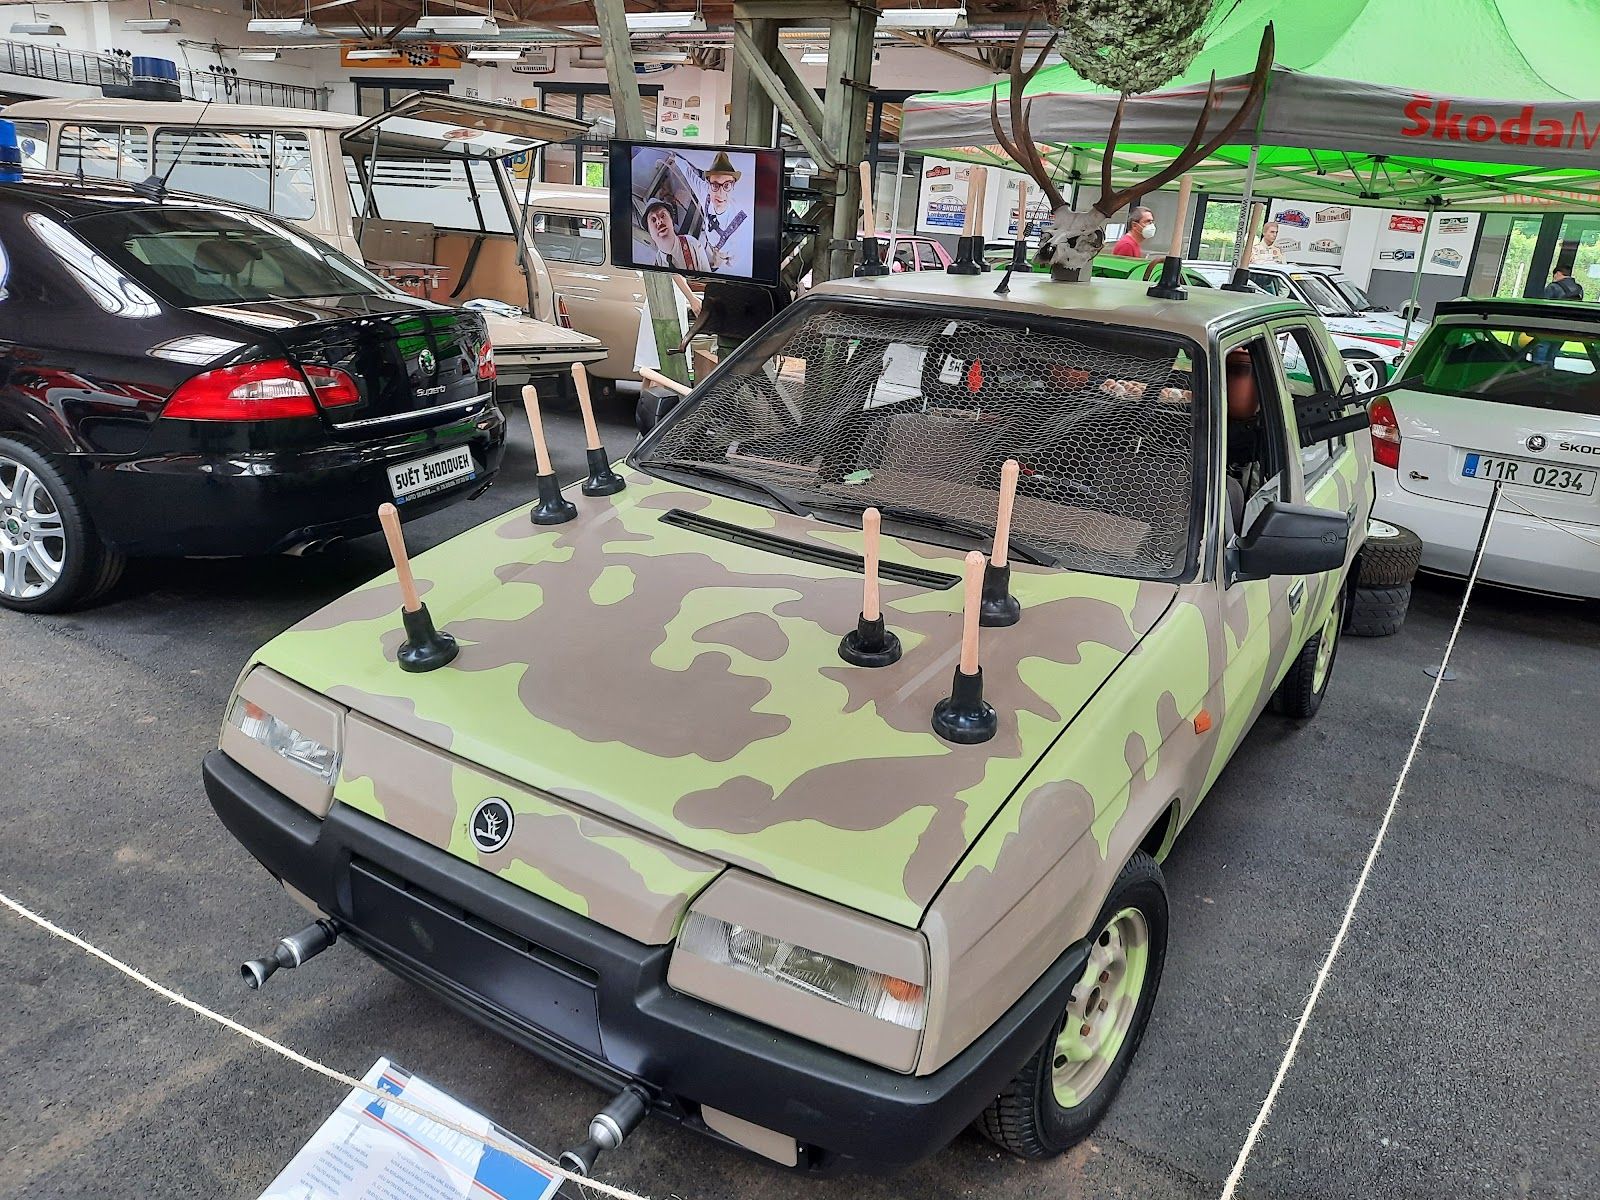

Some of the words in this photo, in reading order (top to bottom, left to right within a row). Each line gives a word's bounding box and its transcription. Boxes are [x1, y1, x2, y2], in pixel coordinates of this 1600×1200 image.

[416, 385, 446, 397] Superb
[395, 467, 420, 490] SVĚT
[422, 453, 470, 481] ŠKODOVEK
[1483, 459, 1519, 481] 11R
[1532, 467, 1583, 491] 0234
